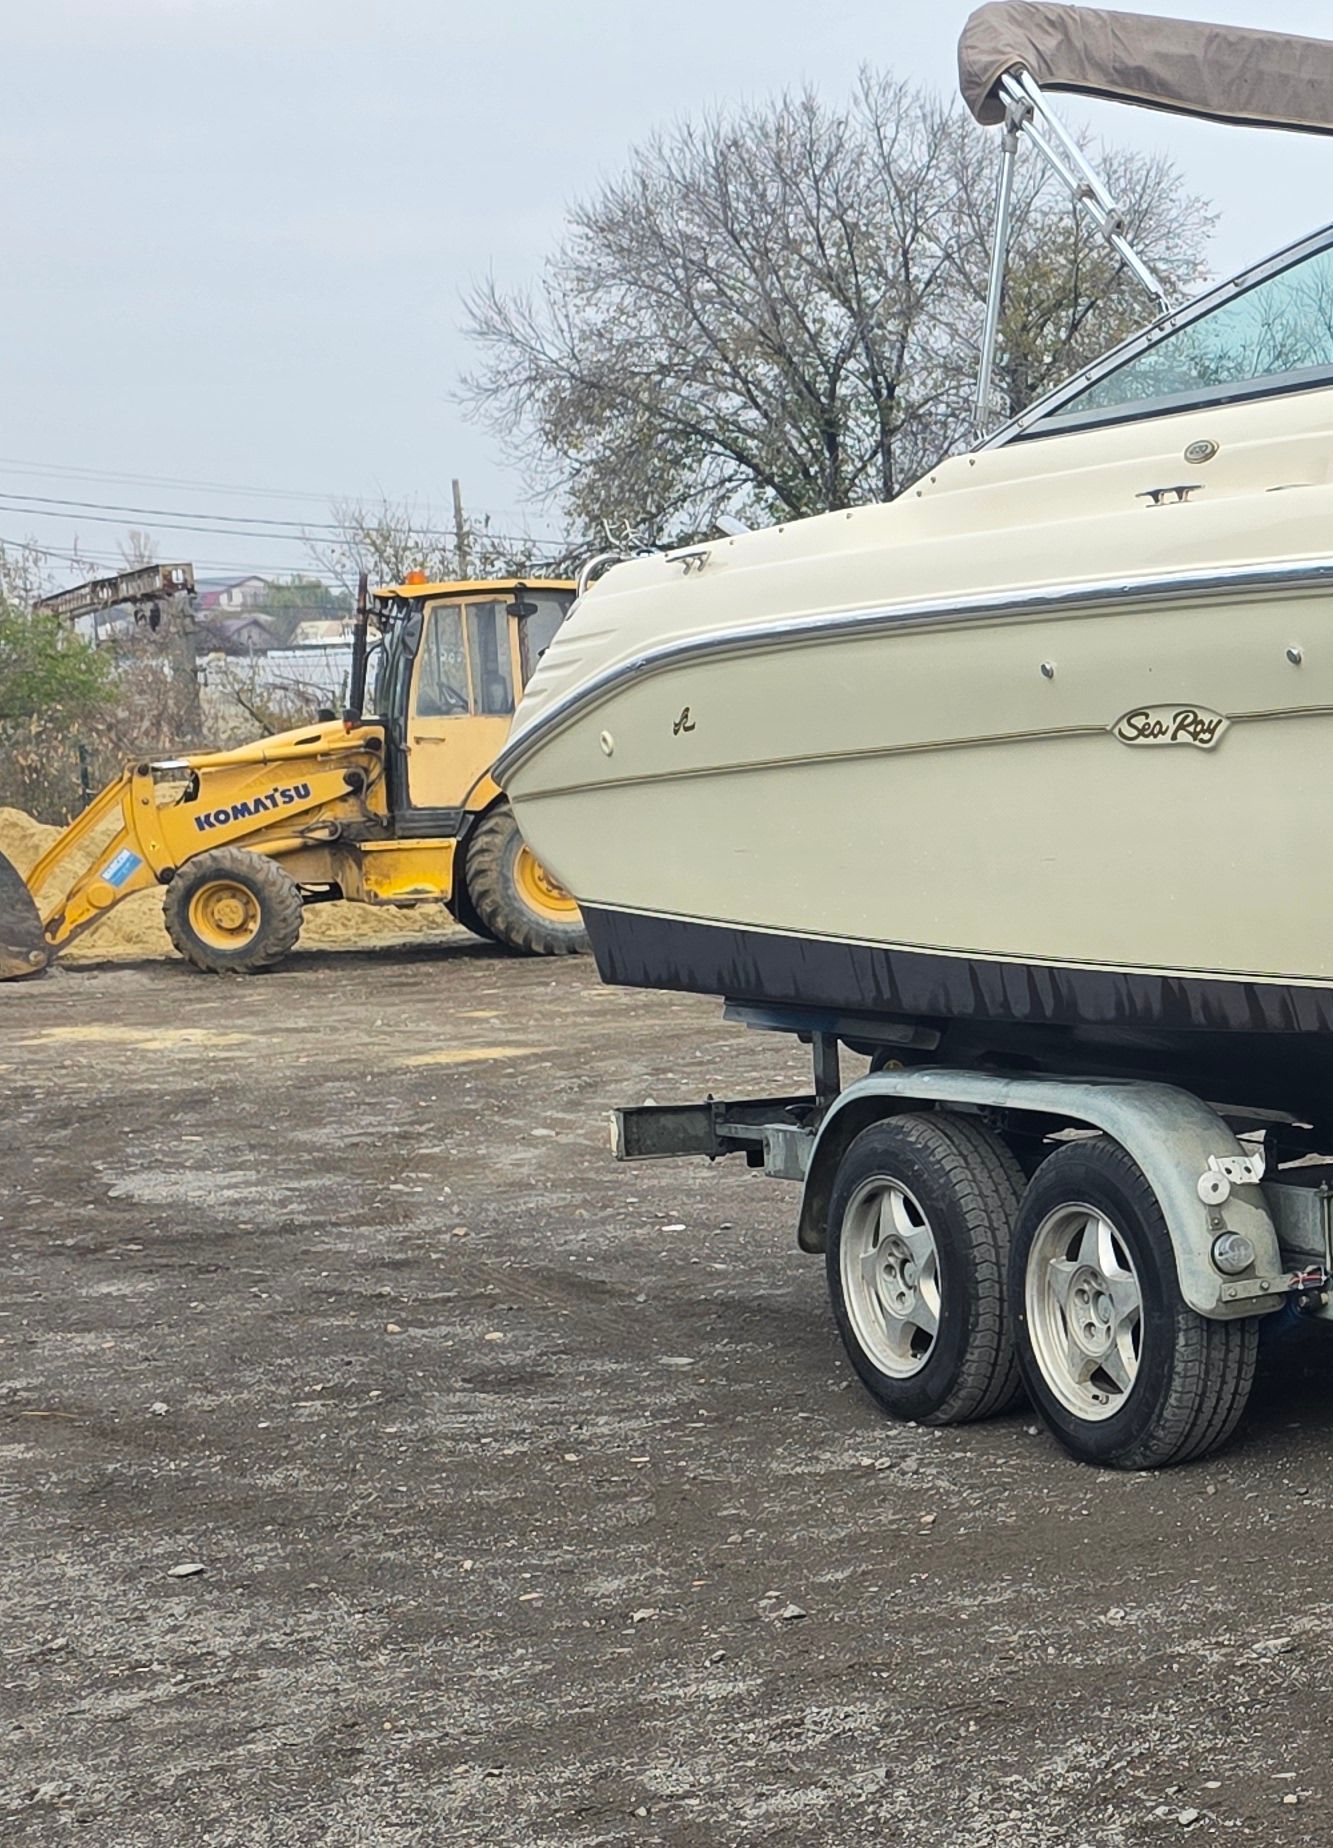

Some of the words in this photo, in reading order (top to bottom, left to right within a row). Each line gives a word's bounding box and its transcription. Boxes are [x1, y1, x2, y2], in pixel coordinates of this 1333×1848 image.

[1117, 710, 1169, 742] Sea
[1169, 709, 1223, 745] Ray
[194, 782, 311, 831] KOMATSU
